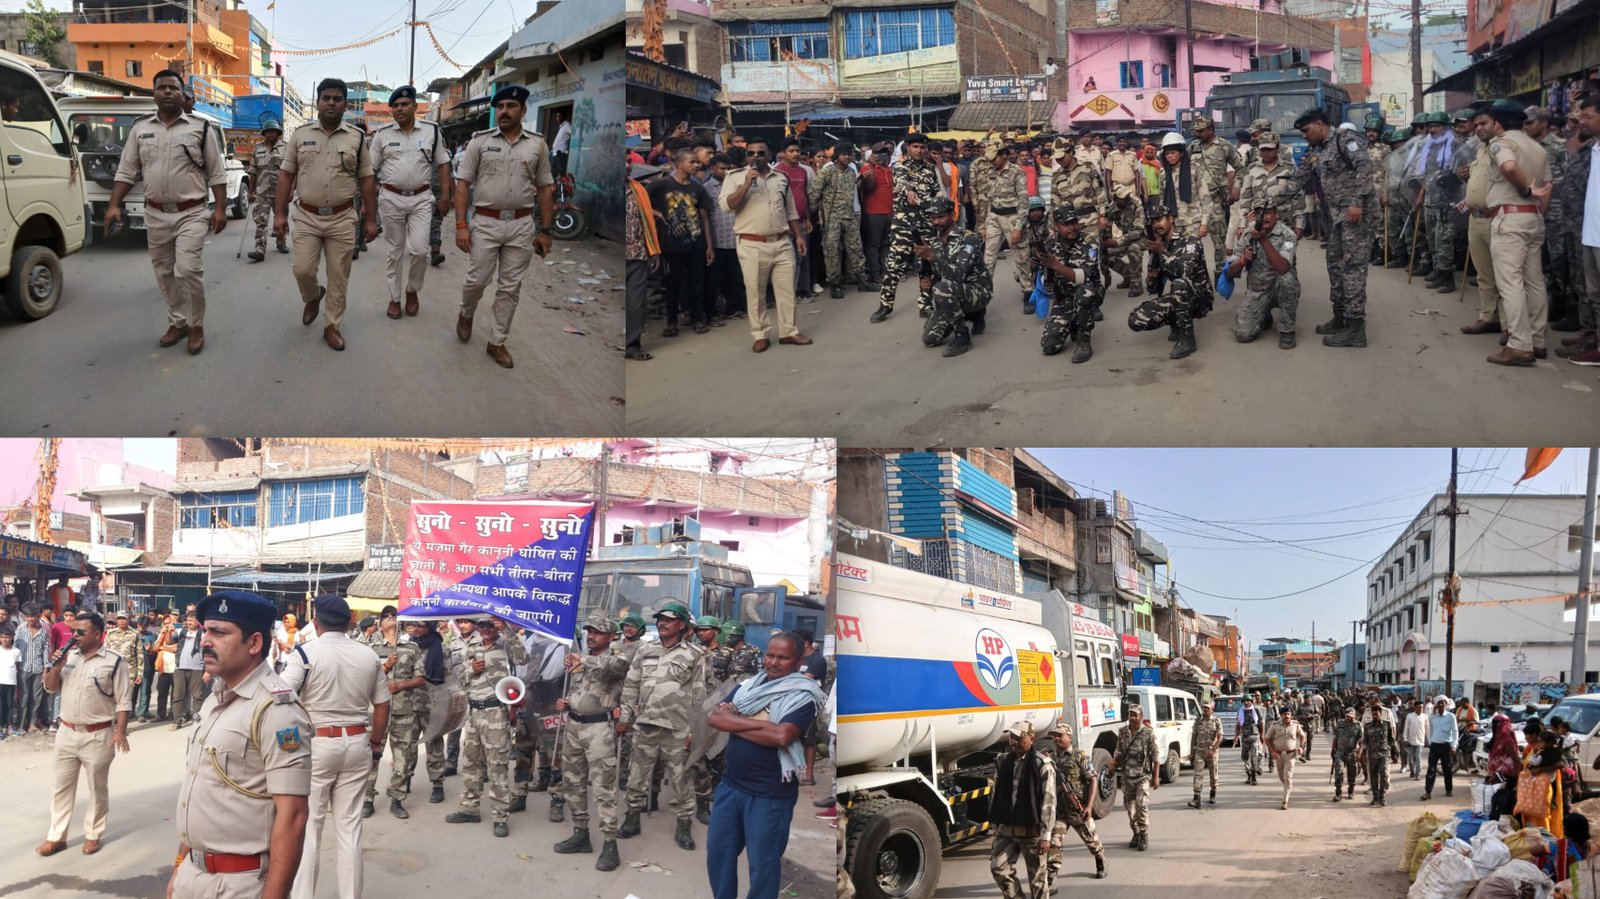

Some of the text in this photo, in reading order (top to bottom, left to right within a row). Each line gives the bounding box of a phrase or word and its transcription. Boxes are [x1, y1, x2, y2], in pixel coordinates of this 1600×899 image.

[967, 79, 986, 88] Yuva
[988, 78, 1013, 88] Smart
[416, 511, 453, 533] सुनो
[475, 512, 515, 537] सुनो
[539, 514, 585, 540] सुनो
[371, 547, 388, 556] Yuva
[426, 542, 455, 553] मजमा
[459, 540, 474, 554] गैर
[477, 544, 514, 560] कानूनी
[519, 545, 557, 560] घोषित
[560, 547, 578, 560] की
[455, 564, 476, 574] आप
[480, 563, 505, 576] सभी
[450, 583, 489, 595] अन्यथा
[492, 586, 528, 599] आपके
[409, 595, 441, 610] कानूनी
[494, 605, 513, 616] की
[982, 636, 1004, 655] HP
